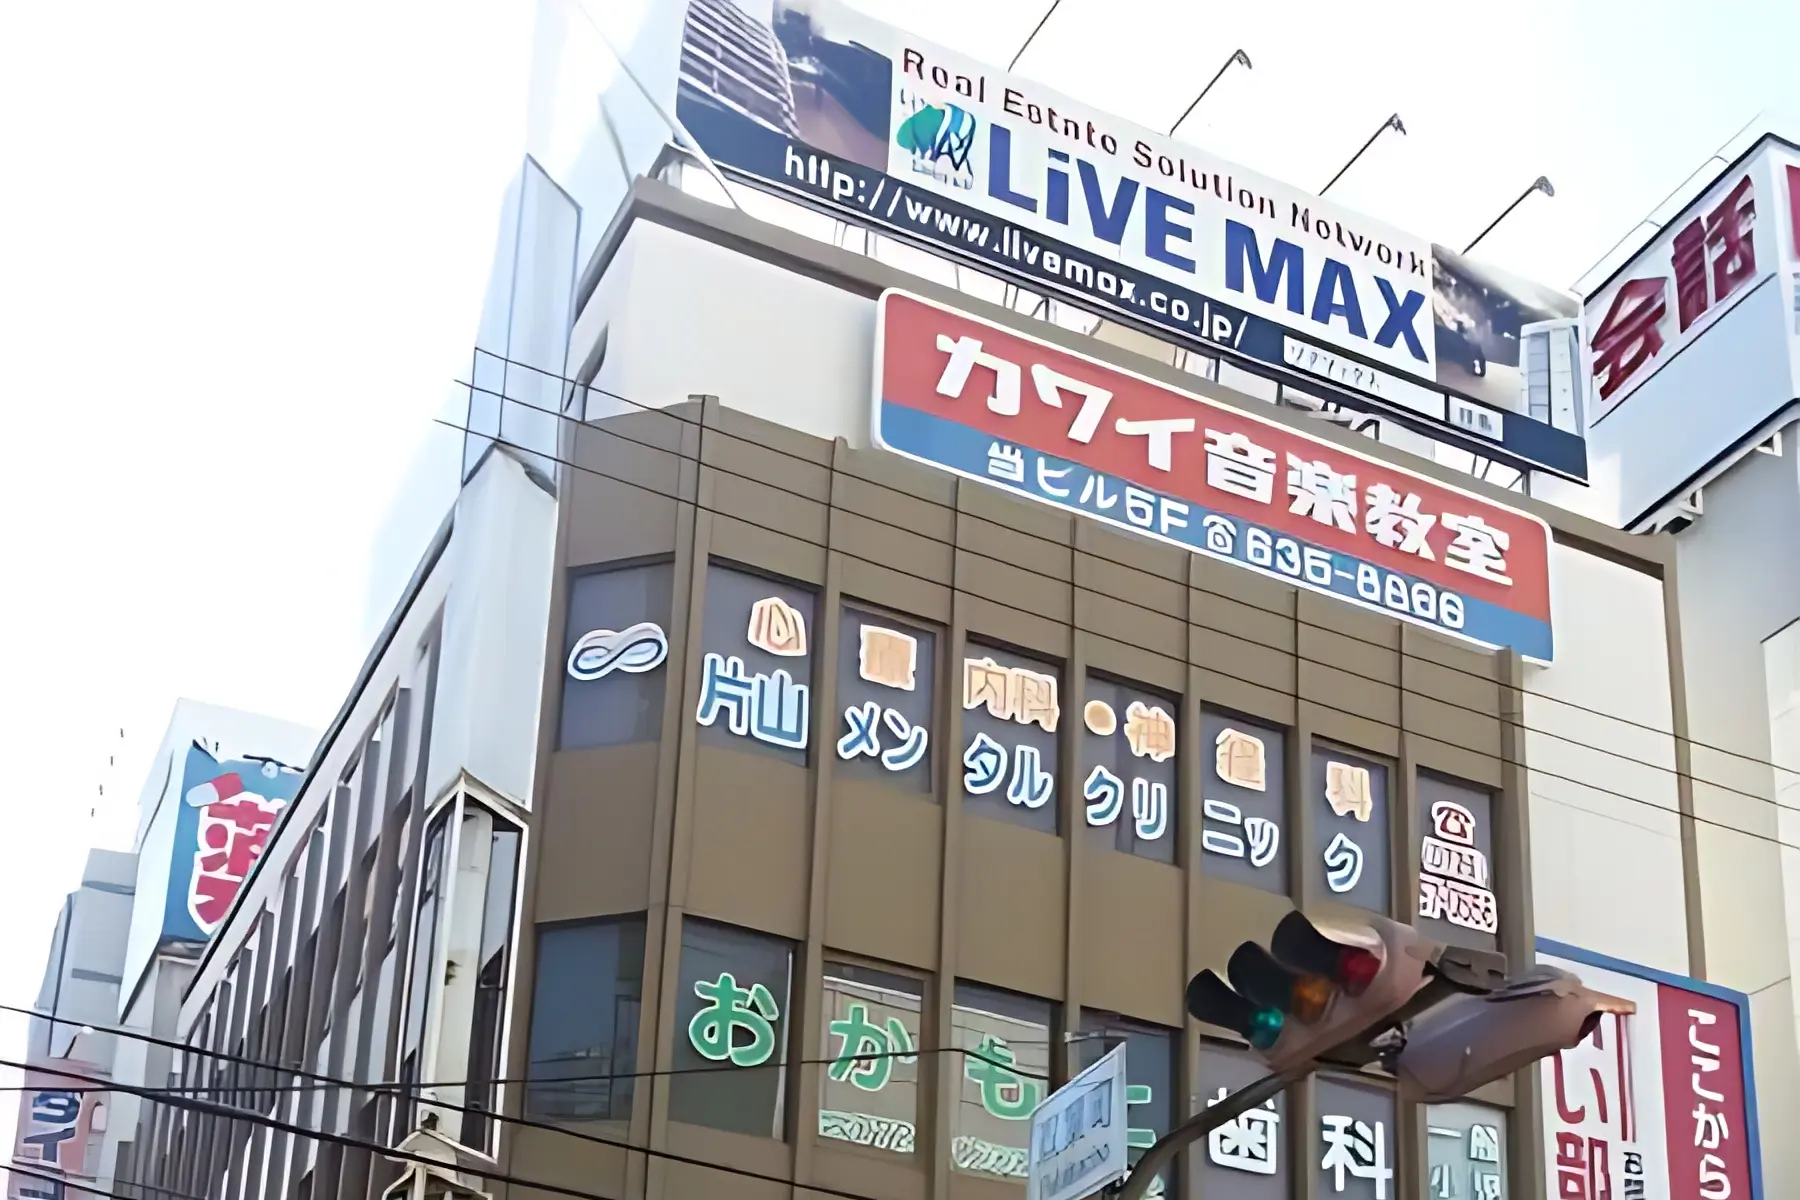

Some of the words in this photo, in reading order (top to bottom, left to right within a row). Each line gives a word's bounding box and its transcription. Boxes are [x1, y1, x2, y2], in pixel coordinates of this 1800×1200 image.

[1225, 219, 1430, 365] MAX
[936, 334, 1514, 586] カワイ音楽教室
